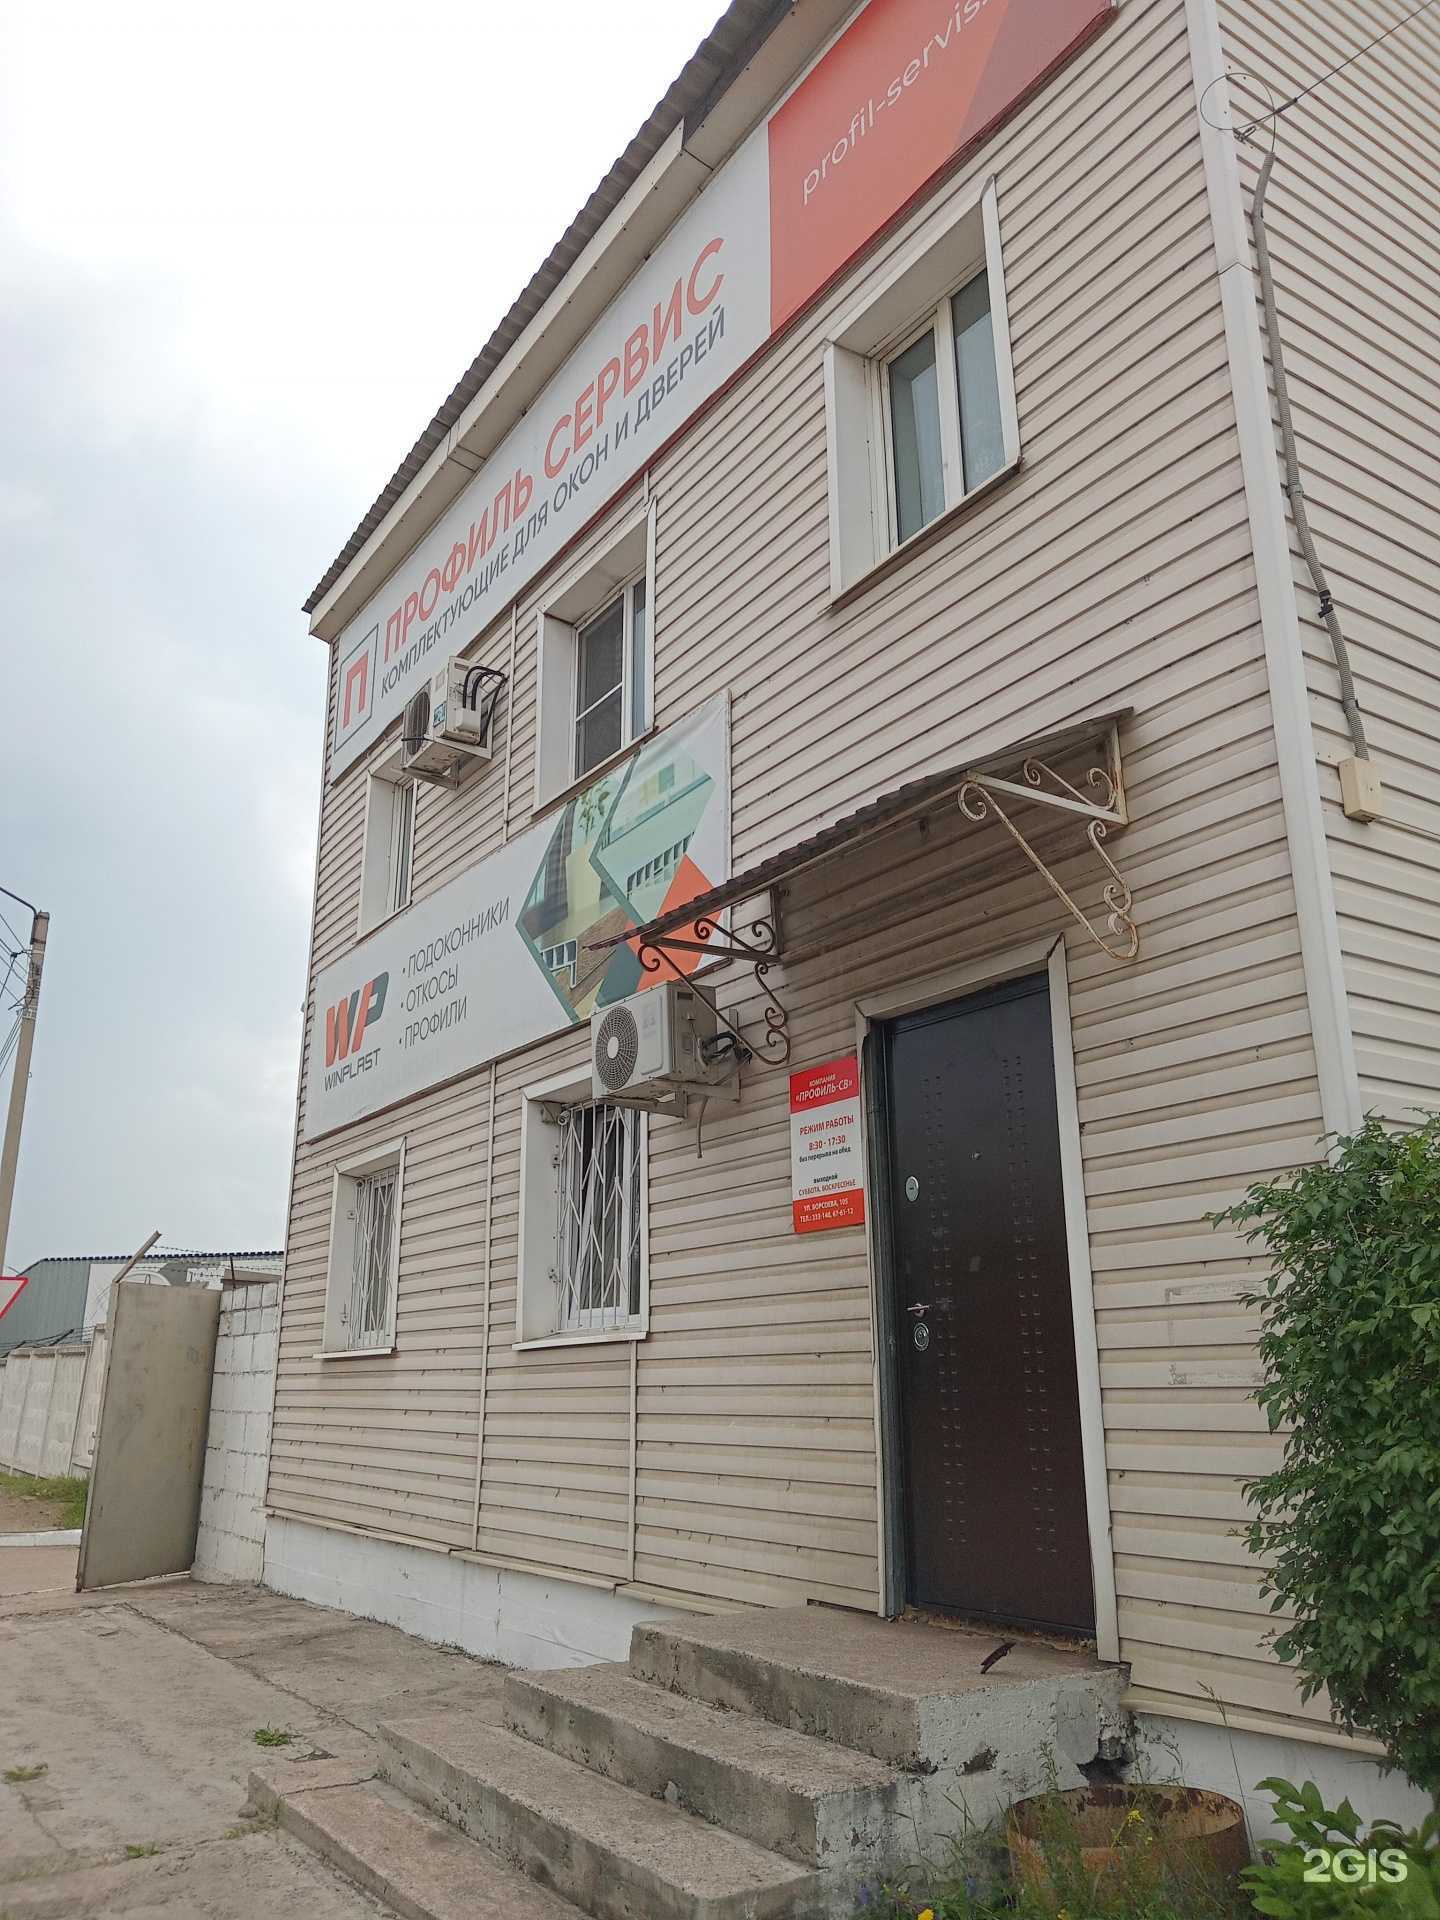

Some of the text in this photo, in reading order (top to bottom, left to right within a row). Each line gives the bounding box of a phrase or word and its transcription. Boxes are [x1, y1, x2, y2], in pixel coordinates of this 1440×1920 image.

[384, 237, 725, 664] ПРОФИЛЬ СЕРВИС
[381, 304, 725, 699] КОМПЛЕКТУЮЩИЕ ДЛЯ ОКОН И ДВЕРЕЙ
[407, 896, 510, 978] ПОДОКОННИКИ
[406, 963, 459, 1012] ОТКОСЫ
[404, 995, 467, 1049] ПРОФИЛИ
[324, 1047, 381, 1092] WINPLAST
[799, 1115, 854, 1136] РЕЖИМ РАБОТЫ
[809, 1140, 823, 1151] 8:30
[828, 1135, 846, 1147] 17:30
